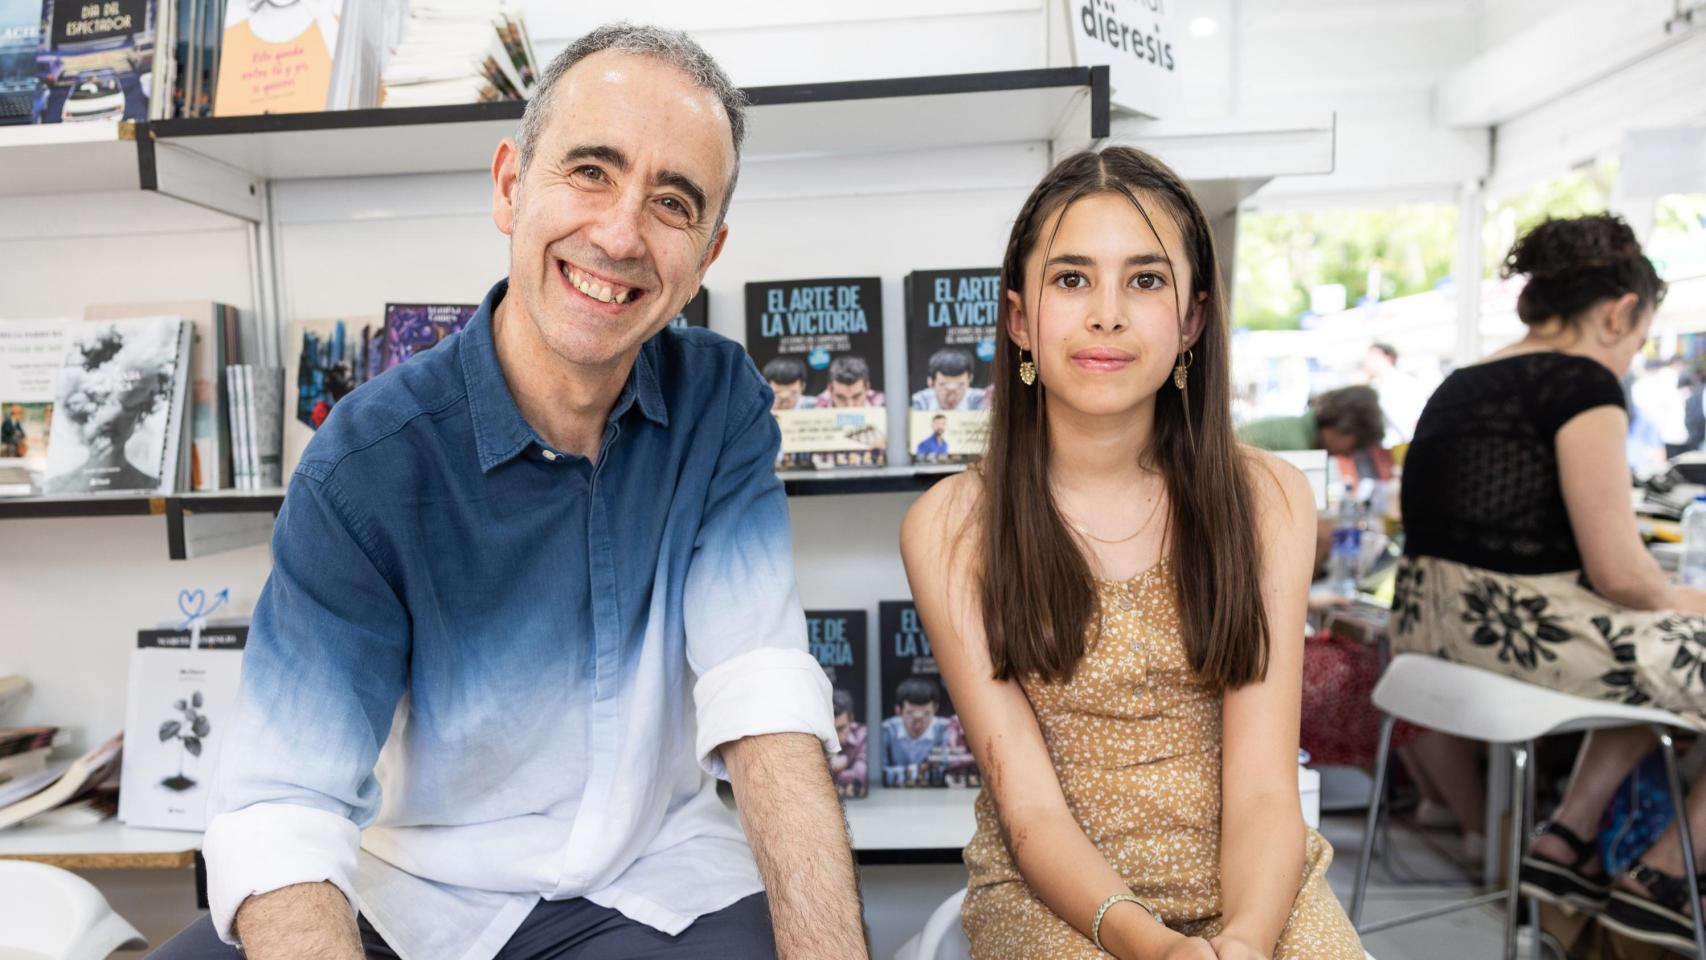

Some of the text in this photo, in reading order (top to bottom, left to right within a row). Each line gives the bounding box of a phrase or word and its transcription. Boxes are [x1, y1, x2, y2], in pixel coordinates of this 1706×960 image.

[65, 14, 131, 36] ESPECTADOR
[767, 284, 861, 313] EL ARTE DE
[935, 277, 955, 303] EL
[761, 307, 868, 337] LA VICTORIA
[928, 301, 998, 328] LA VICT
[824, 617, 848, 642] DE
[901, 608, 920, 634] EL
[895, 632, 917, 657] LA
